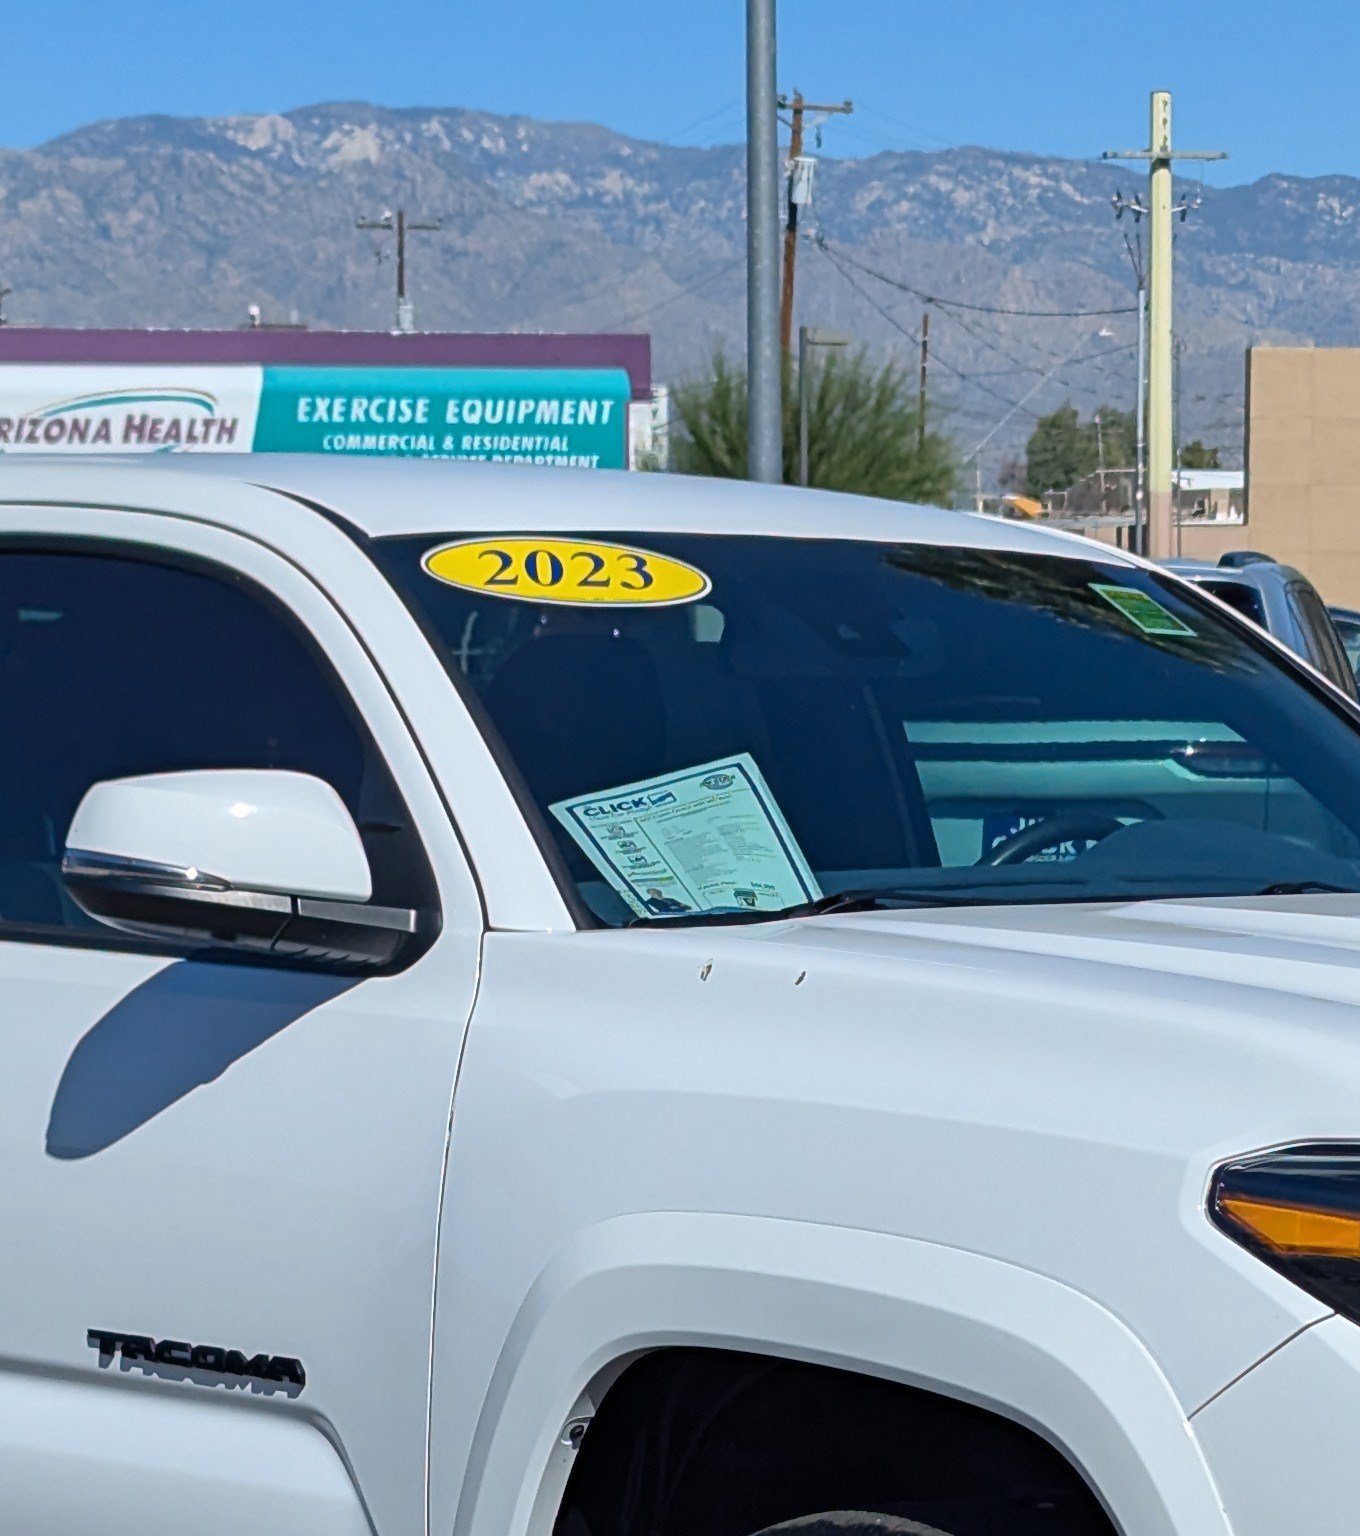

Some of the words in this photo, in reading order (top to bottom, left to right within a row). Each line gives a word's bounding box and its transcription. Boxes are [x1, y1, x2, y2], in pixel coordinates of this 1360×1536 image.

[296, 396, 431, 424] EXERCISE
[444, 399, 616, 425] EQUIPMENT
[121, 413, 239, 445] HEALTH
[322, 434, 436, 451] COMMERCIAL
[442, 435, 454, 451] &
[461, 435, 570, 452] RESIDENTIAL
[478, 549, 654, 590] 2023
[583, 797, 645, 817] CLICK
[87, 1328, 307, 1389] TACOMA
